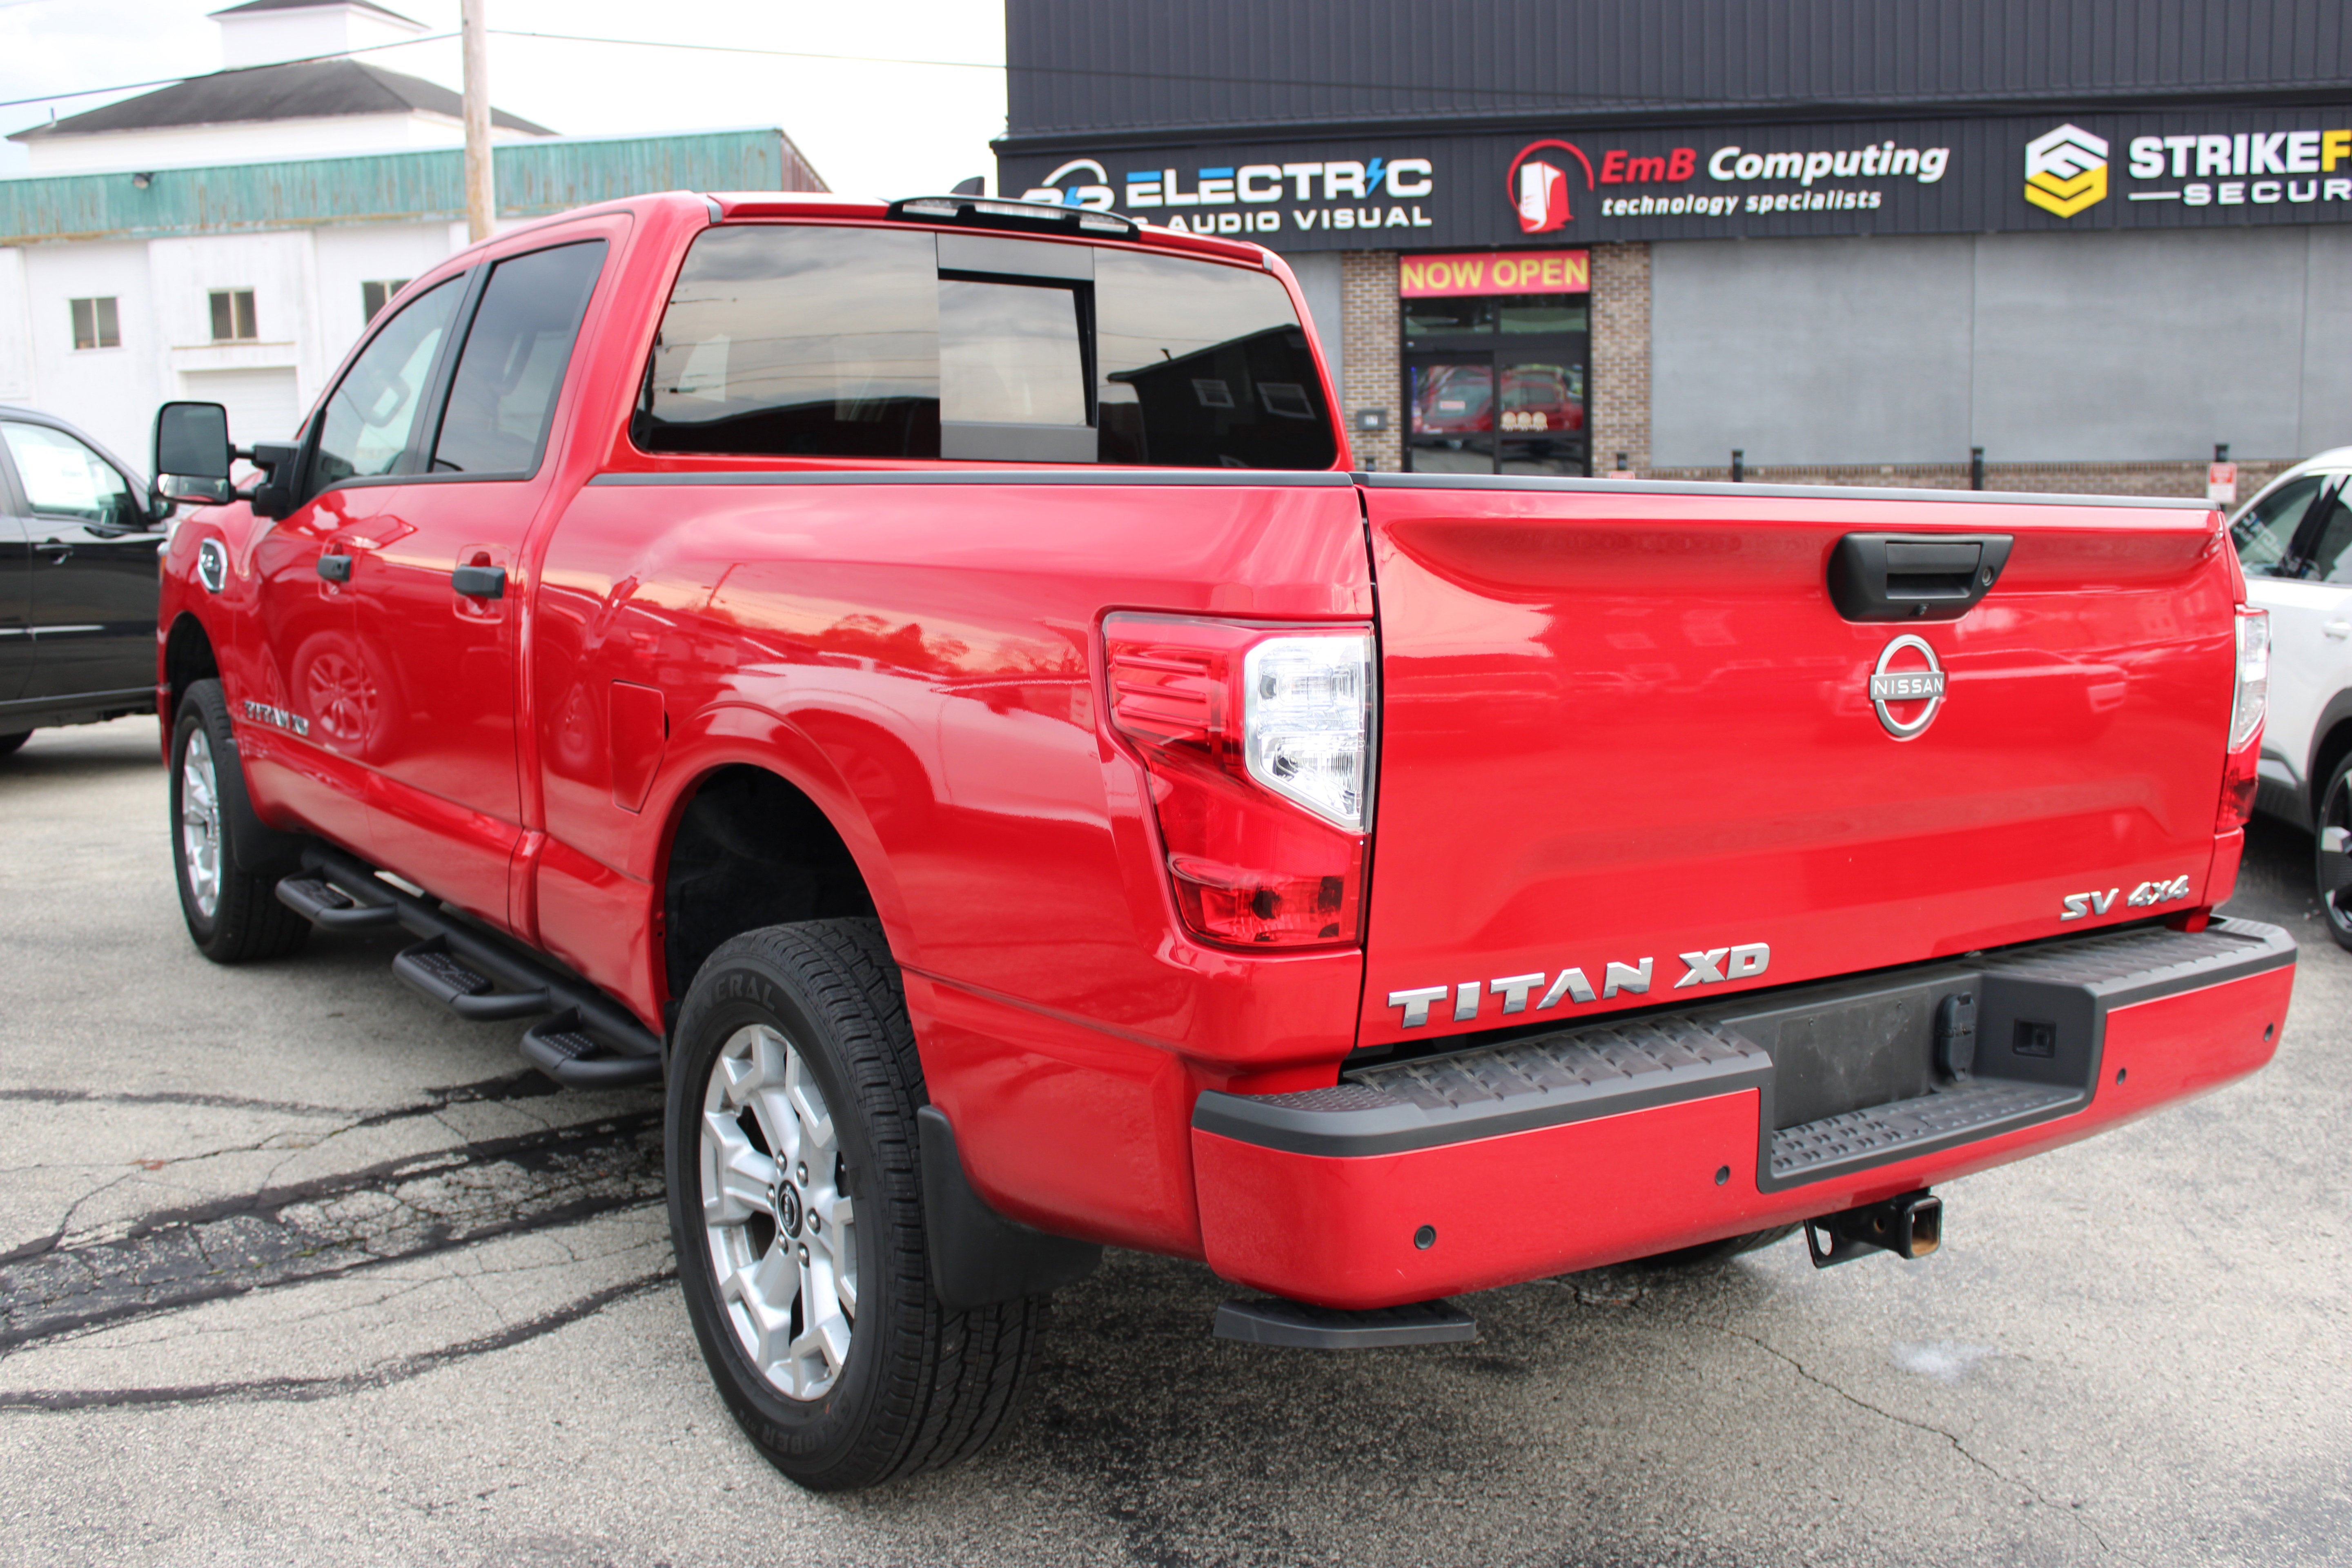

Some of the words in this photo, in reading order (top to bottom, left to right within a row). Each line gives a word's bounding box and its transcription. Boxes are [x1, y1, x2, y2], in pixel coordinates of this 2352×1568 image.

[1599, 147, 1697, 184] EmB
[1708, 140, 1950, 187] Computing
[1601, 194, 1739, 216] technology
[1744, 189, 1882, 215] specialists
[1167, 210, 1281, 235] AUDIO
[1292, 206, 1432, 231] VISUAL
[1401, 260, 1484, 290] NOW
[1491, 257, 1588, 287] OPEN
[1874, 677, 1943, 695] NISSAN
[2060, 888, 2120, 921] SV
[1388, 957, 1654, 1029] TITAN
[1674, 942, 1771, 989] XD
